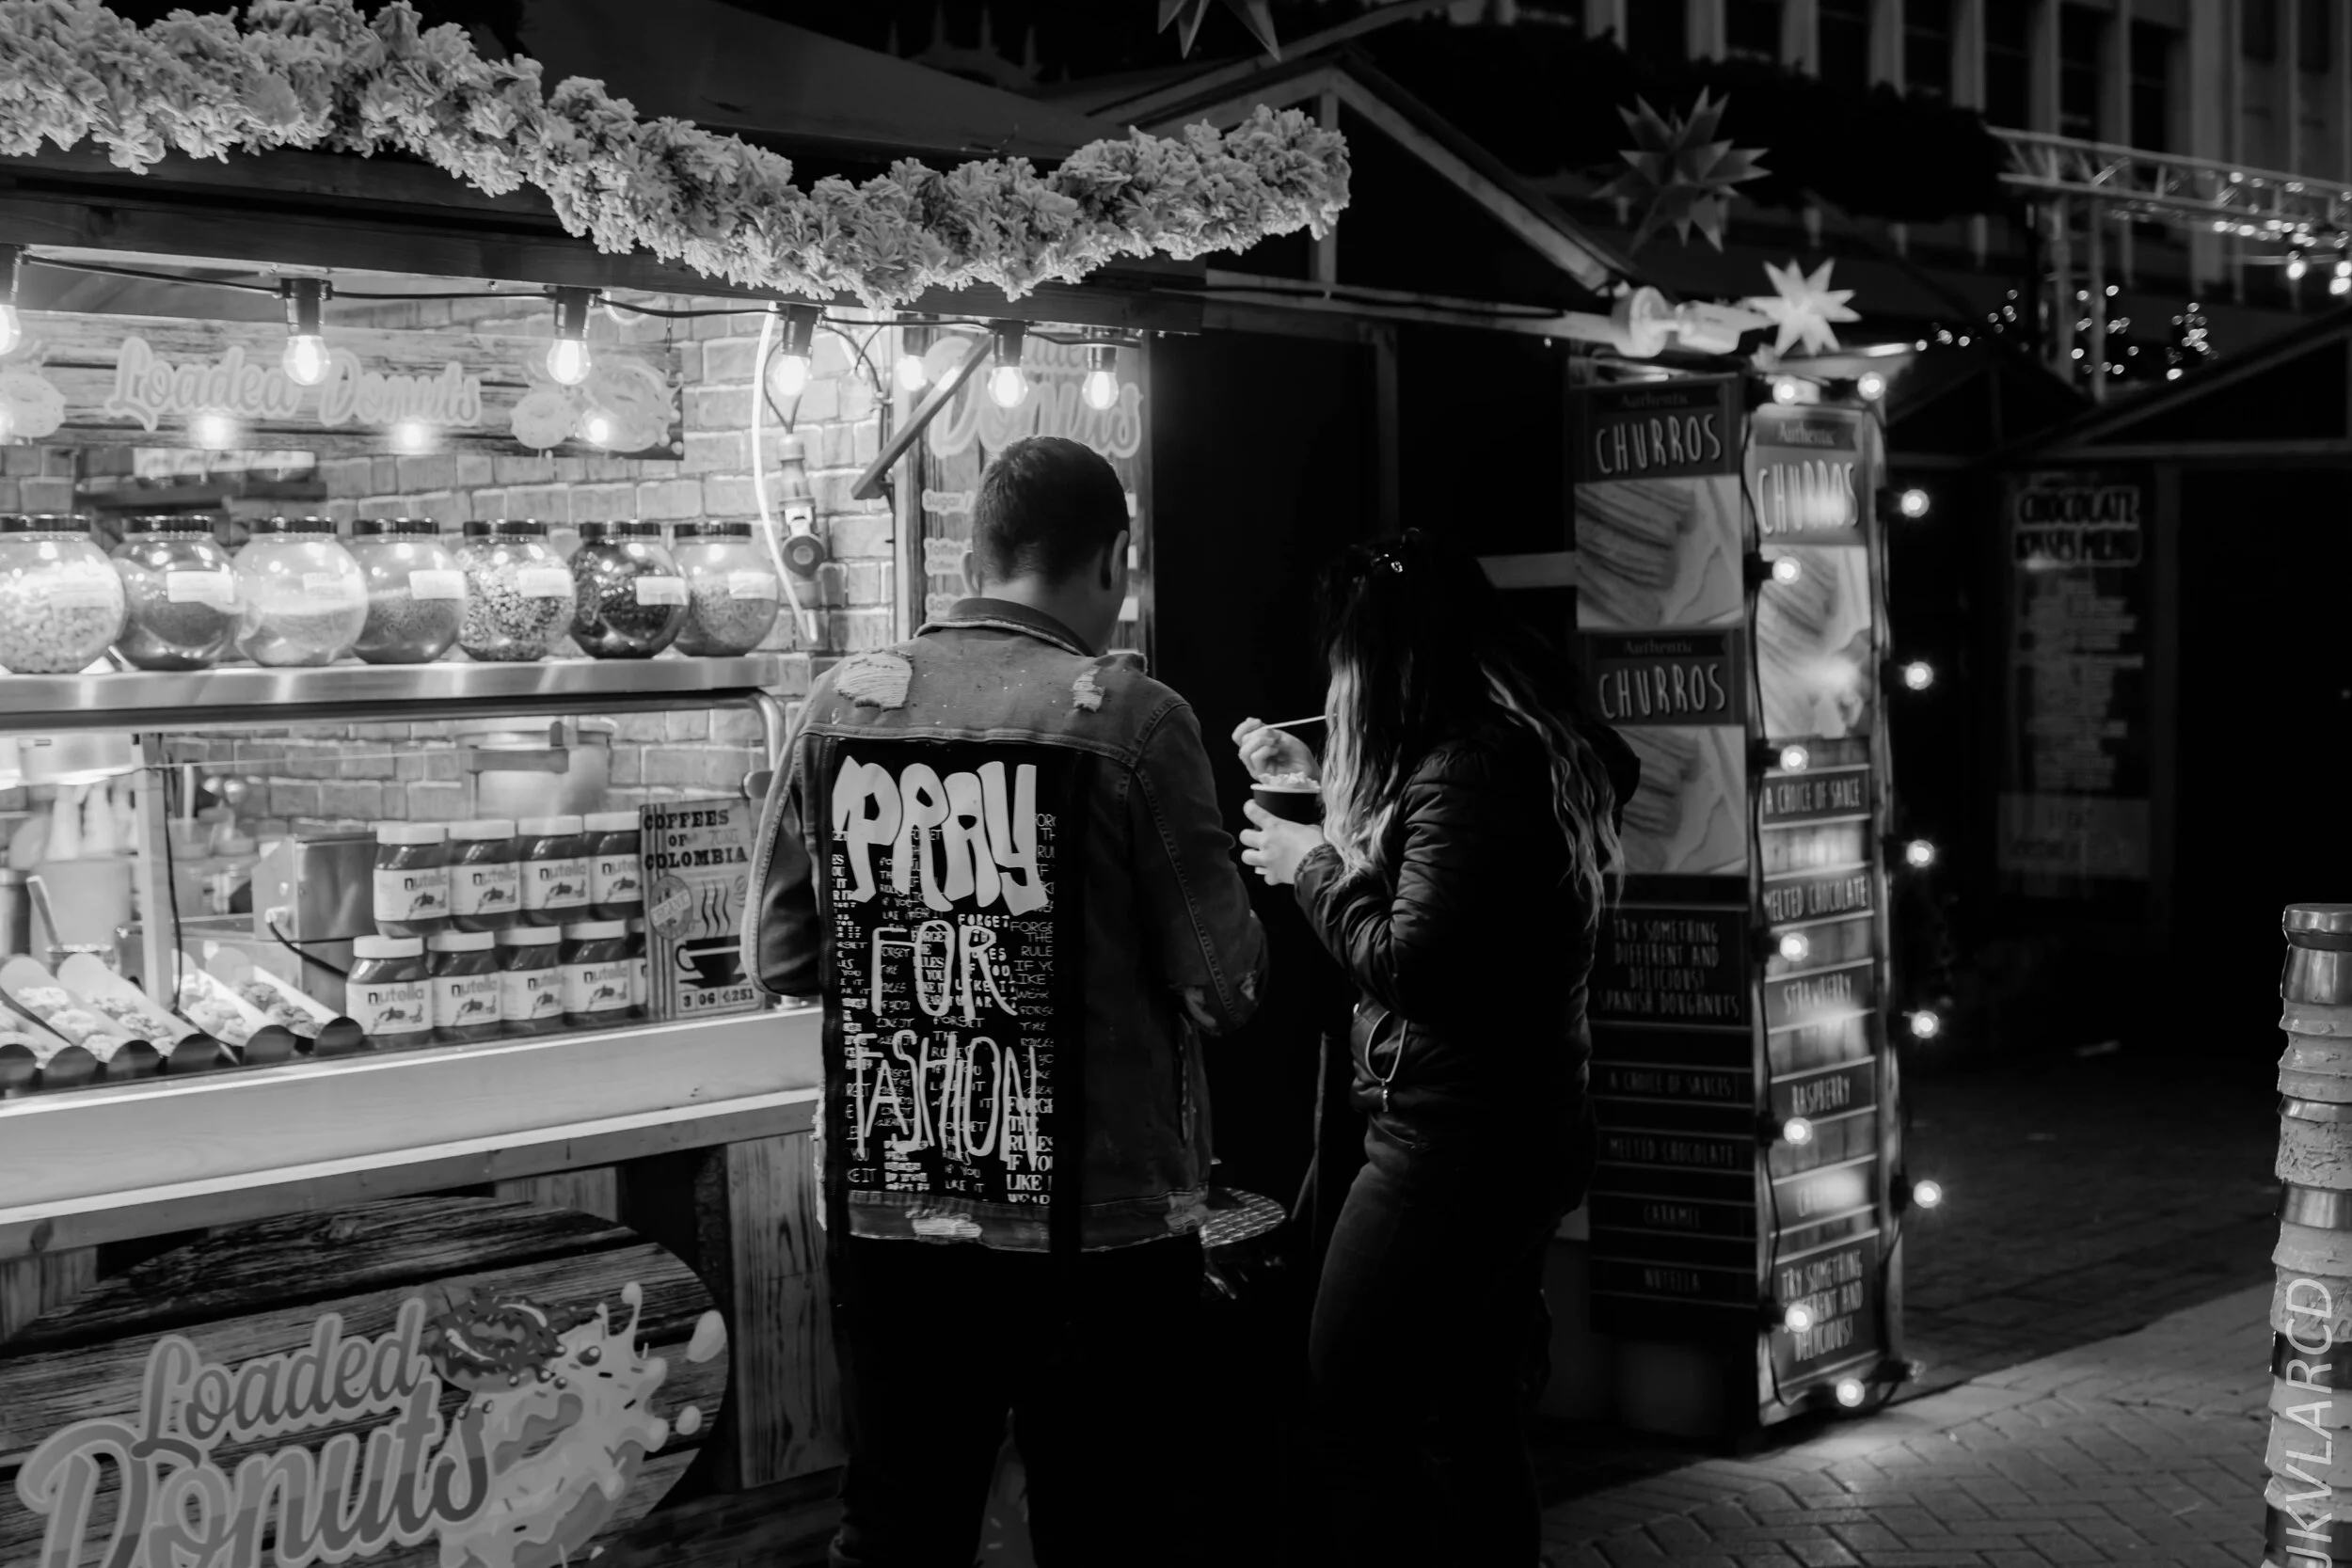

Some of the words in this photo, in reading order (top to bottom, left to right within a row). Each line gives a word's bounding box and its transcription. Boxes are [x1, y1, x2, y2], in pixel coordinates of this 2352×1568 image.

[104, 337, 301, 432] Loaded
[319, 347, 482, 427] Donuts
[1596, 413, 1722, 474] CHURROS
[1599, 663, 1726, 720] CHURROS
[644, 809, 730, 832] COFFEES
[668, 833, 688, 847] OF
[832, 754, 1050, 916] PRAY
[644, 846, 749, 870] COLOMBIA
[405, 867, 447, 892] nutella
[472, 864, 517, 887] nutella
[539, 860, 587, 882] nutella
[958, 913, 1011, 929] FORGET
[583, 965, 628, 985] nutella
[870, 919, 1020, 1022] FOR
[368, 984, 424, 1006] nutella
[451, 977, 498, 998] nutella
[853, 1029, 1038, 1172] FASHION
[960, 1165, 982, 1179] YOU
[1006, 1175, 1042, 1191] LIKE
[132, 1298, 433, 1468] Loaded
[15, 1374, 490, 1568] Donuts
